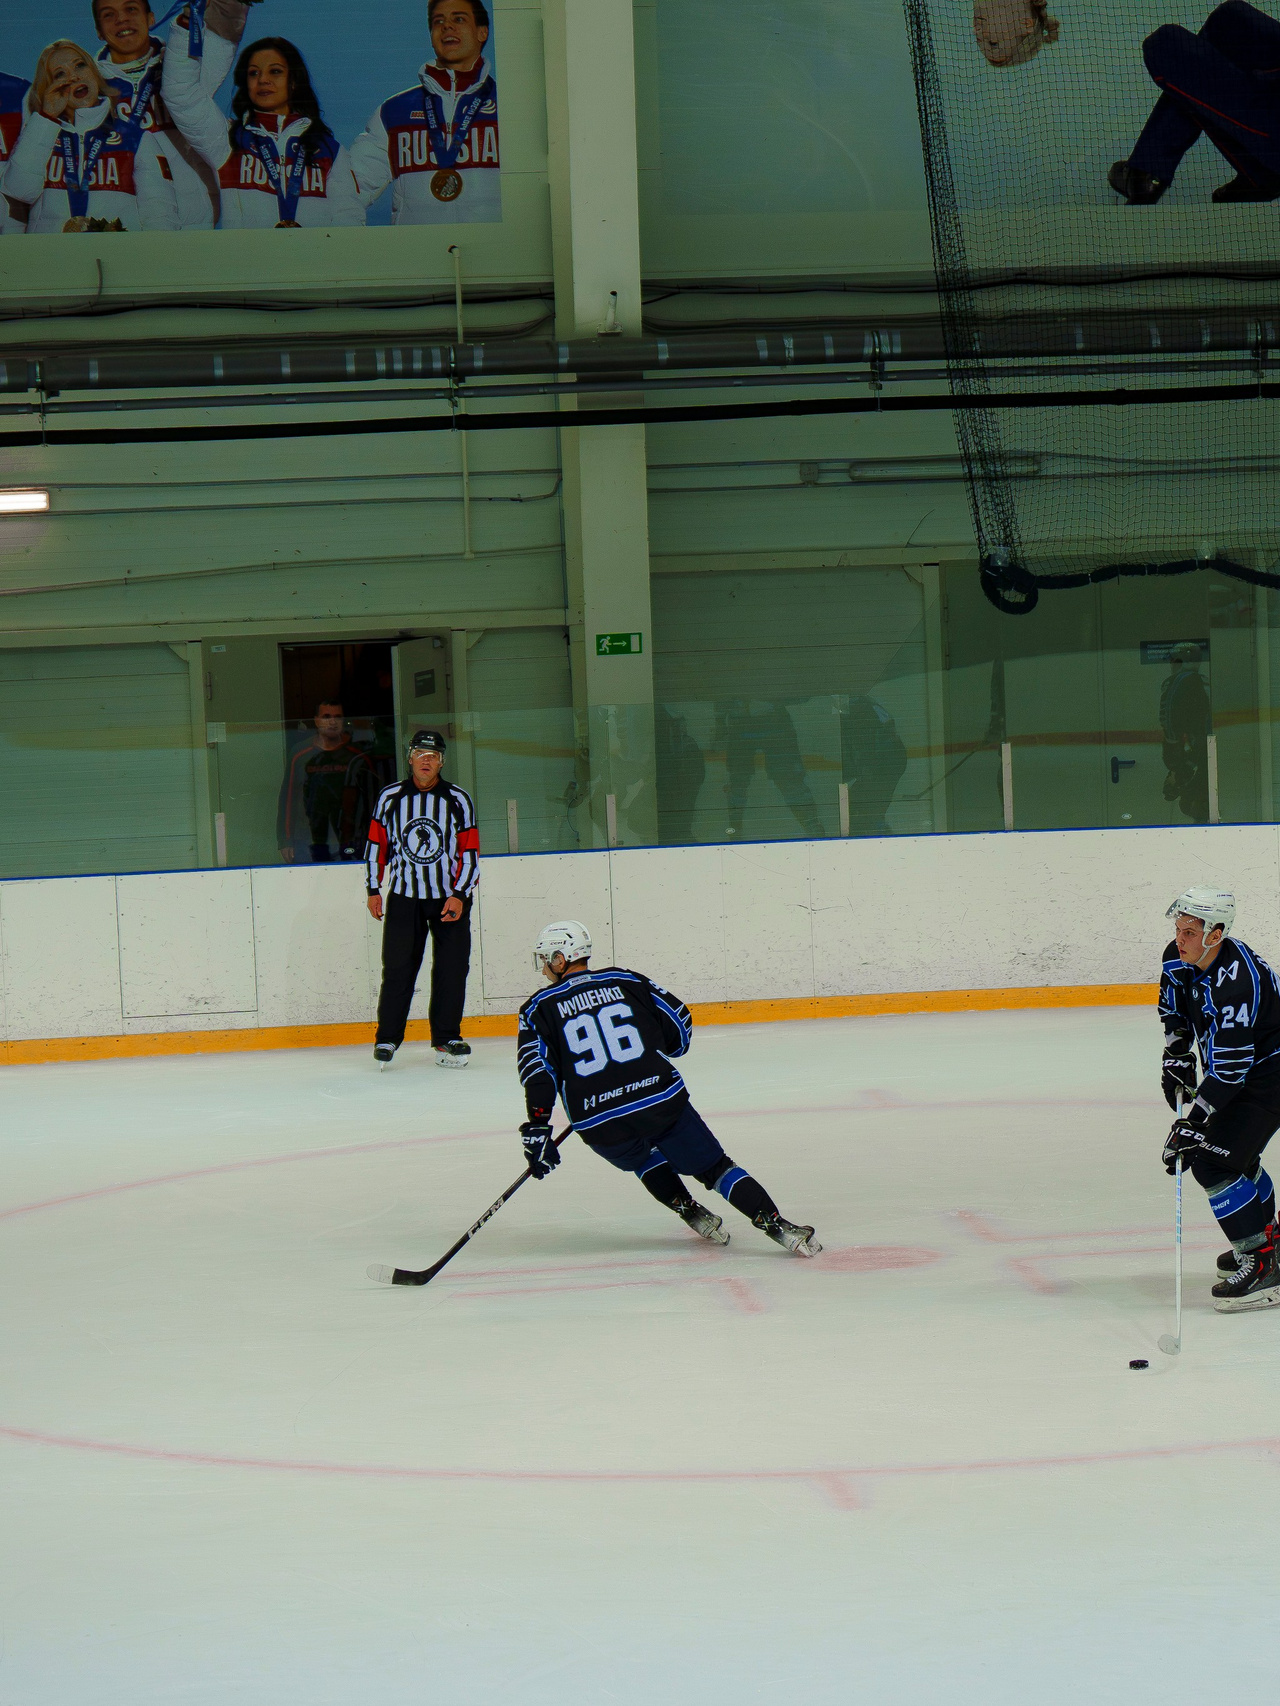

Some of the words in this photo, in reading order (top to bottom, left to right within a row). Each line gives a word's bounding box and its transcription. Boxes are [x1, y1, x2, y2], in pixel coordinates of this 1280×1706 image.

[557, 986, 625, 1019] МУЩЕНКО
[1221, 1003, 1250, 1028] 24
[563, 1003, 645, 1078] 96
[598, 1088, 624, 1104] ONE
[624, 1075, 660, 1094] TIMER
